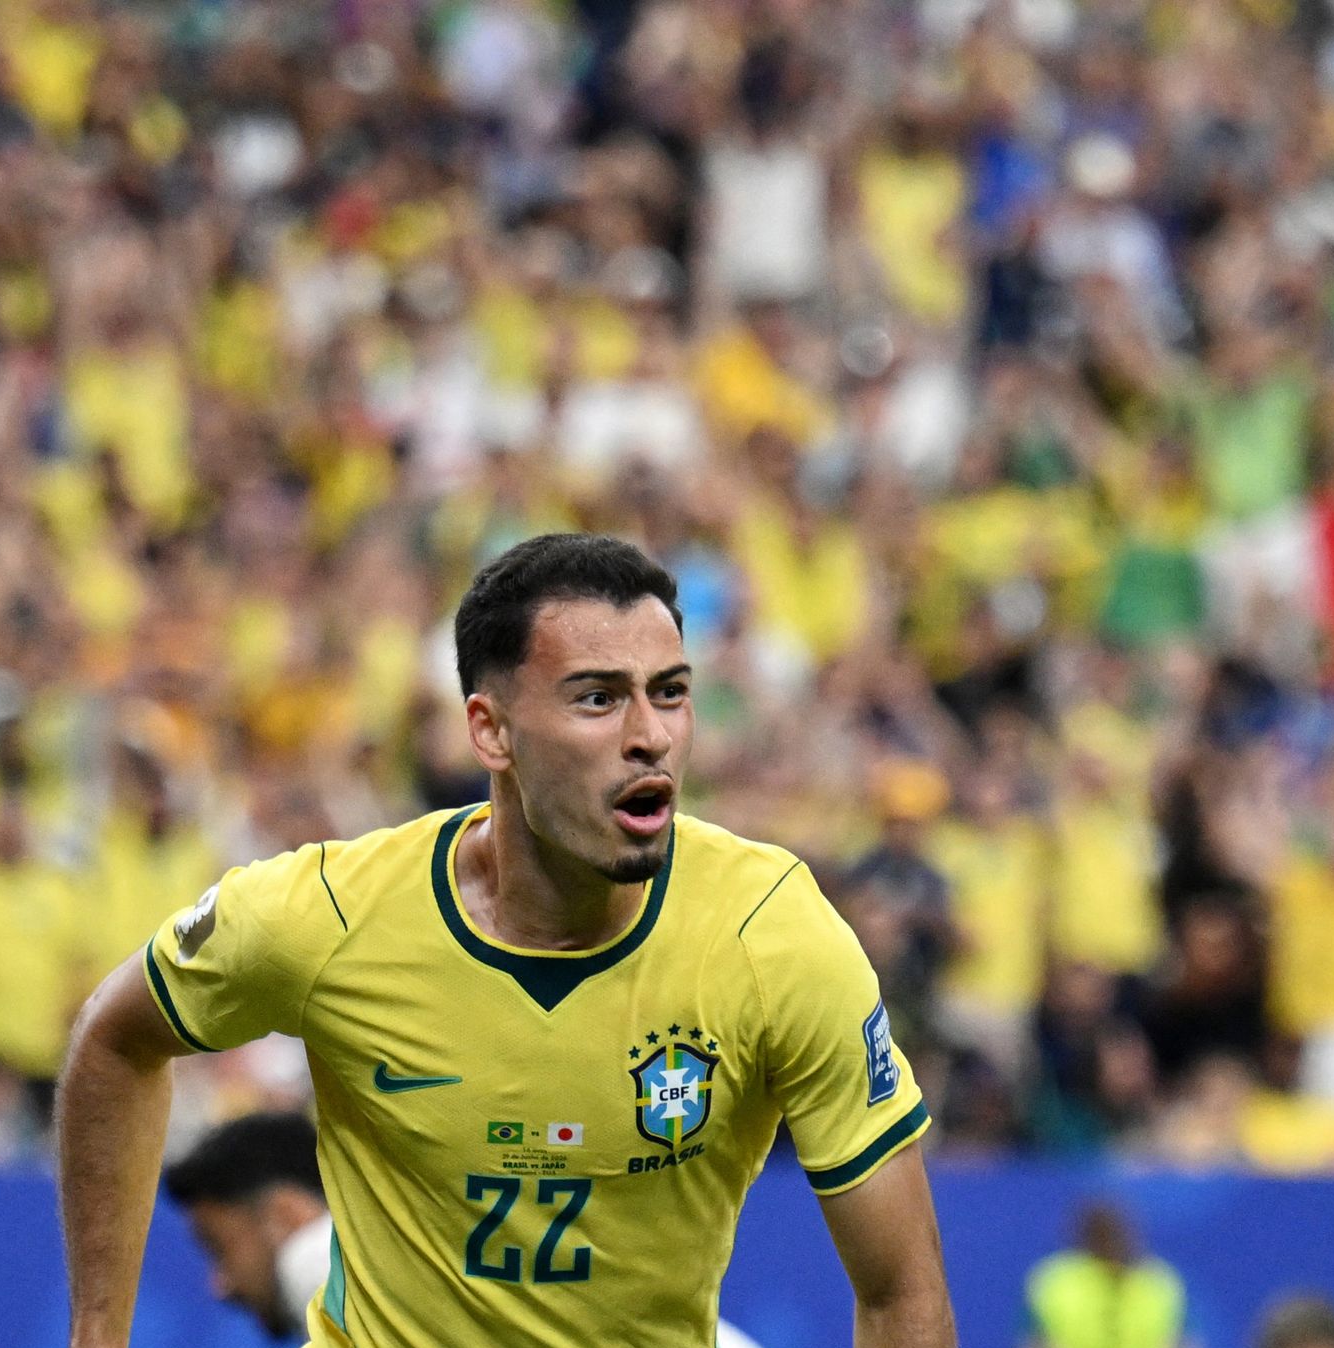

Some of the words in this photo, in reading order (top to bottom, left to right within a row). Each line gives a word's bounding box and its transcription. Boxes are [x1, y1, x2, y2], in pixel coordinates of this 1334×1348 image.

[659, 1086, 689, 1101] CBF
[541, 1161, 566, 1169] JAPÃO
[628, 1142, 705, 1174] BRASIL
[465, 1173, 593, 1283] 22
